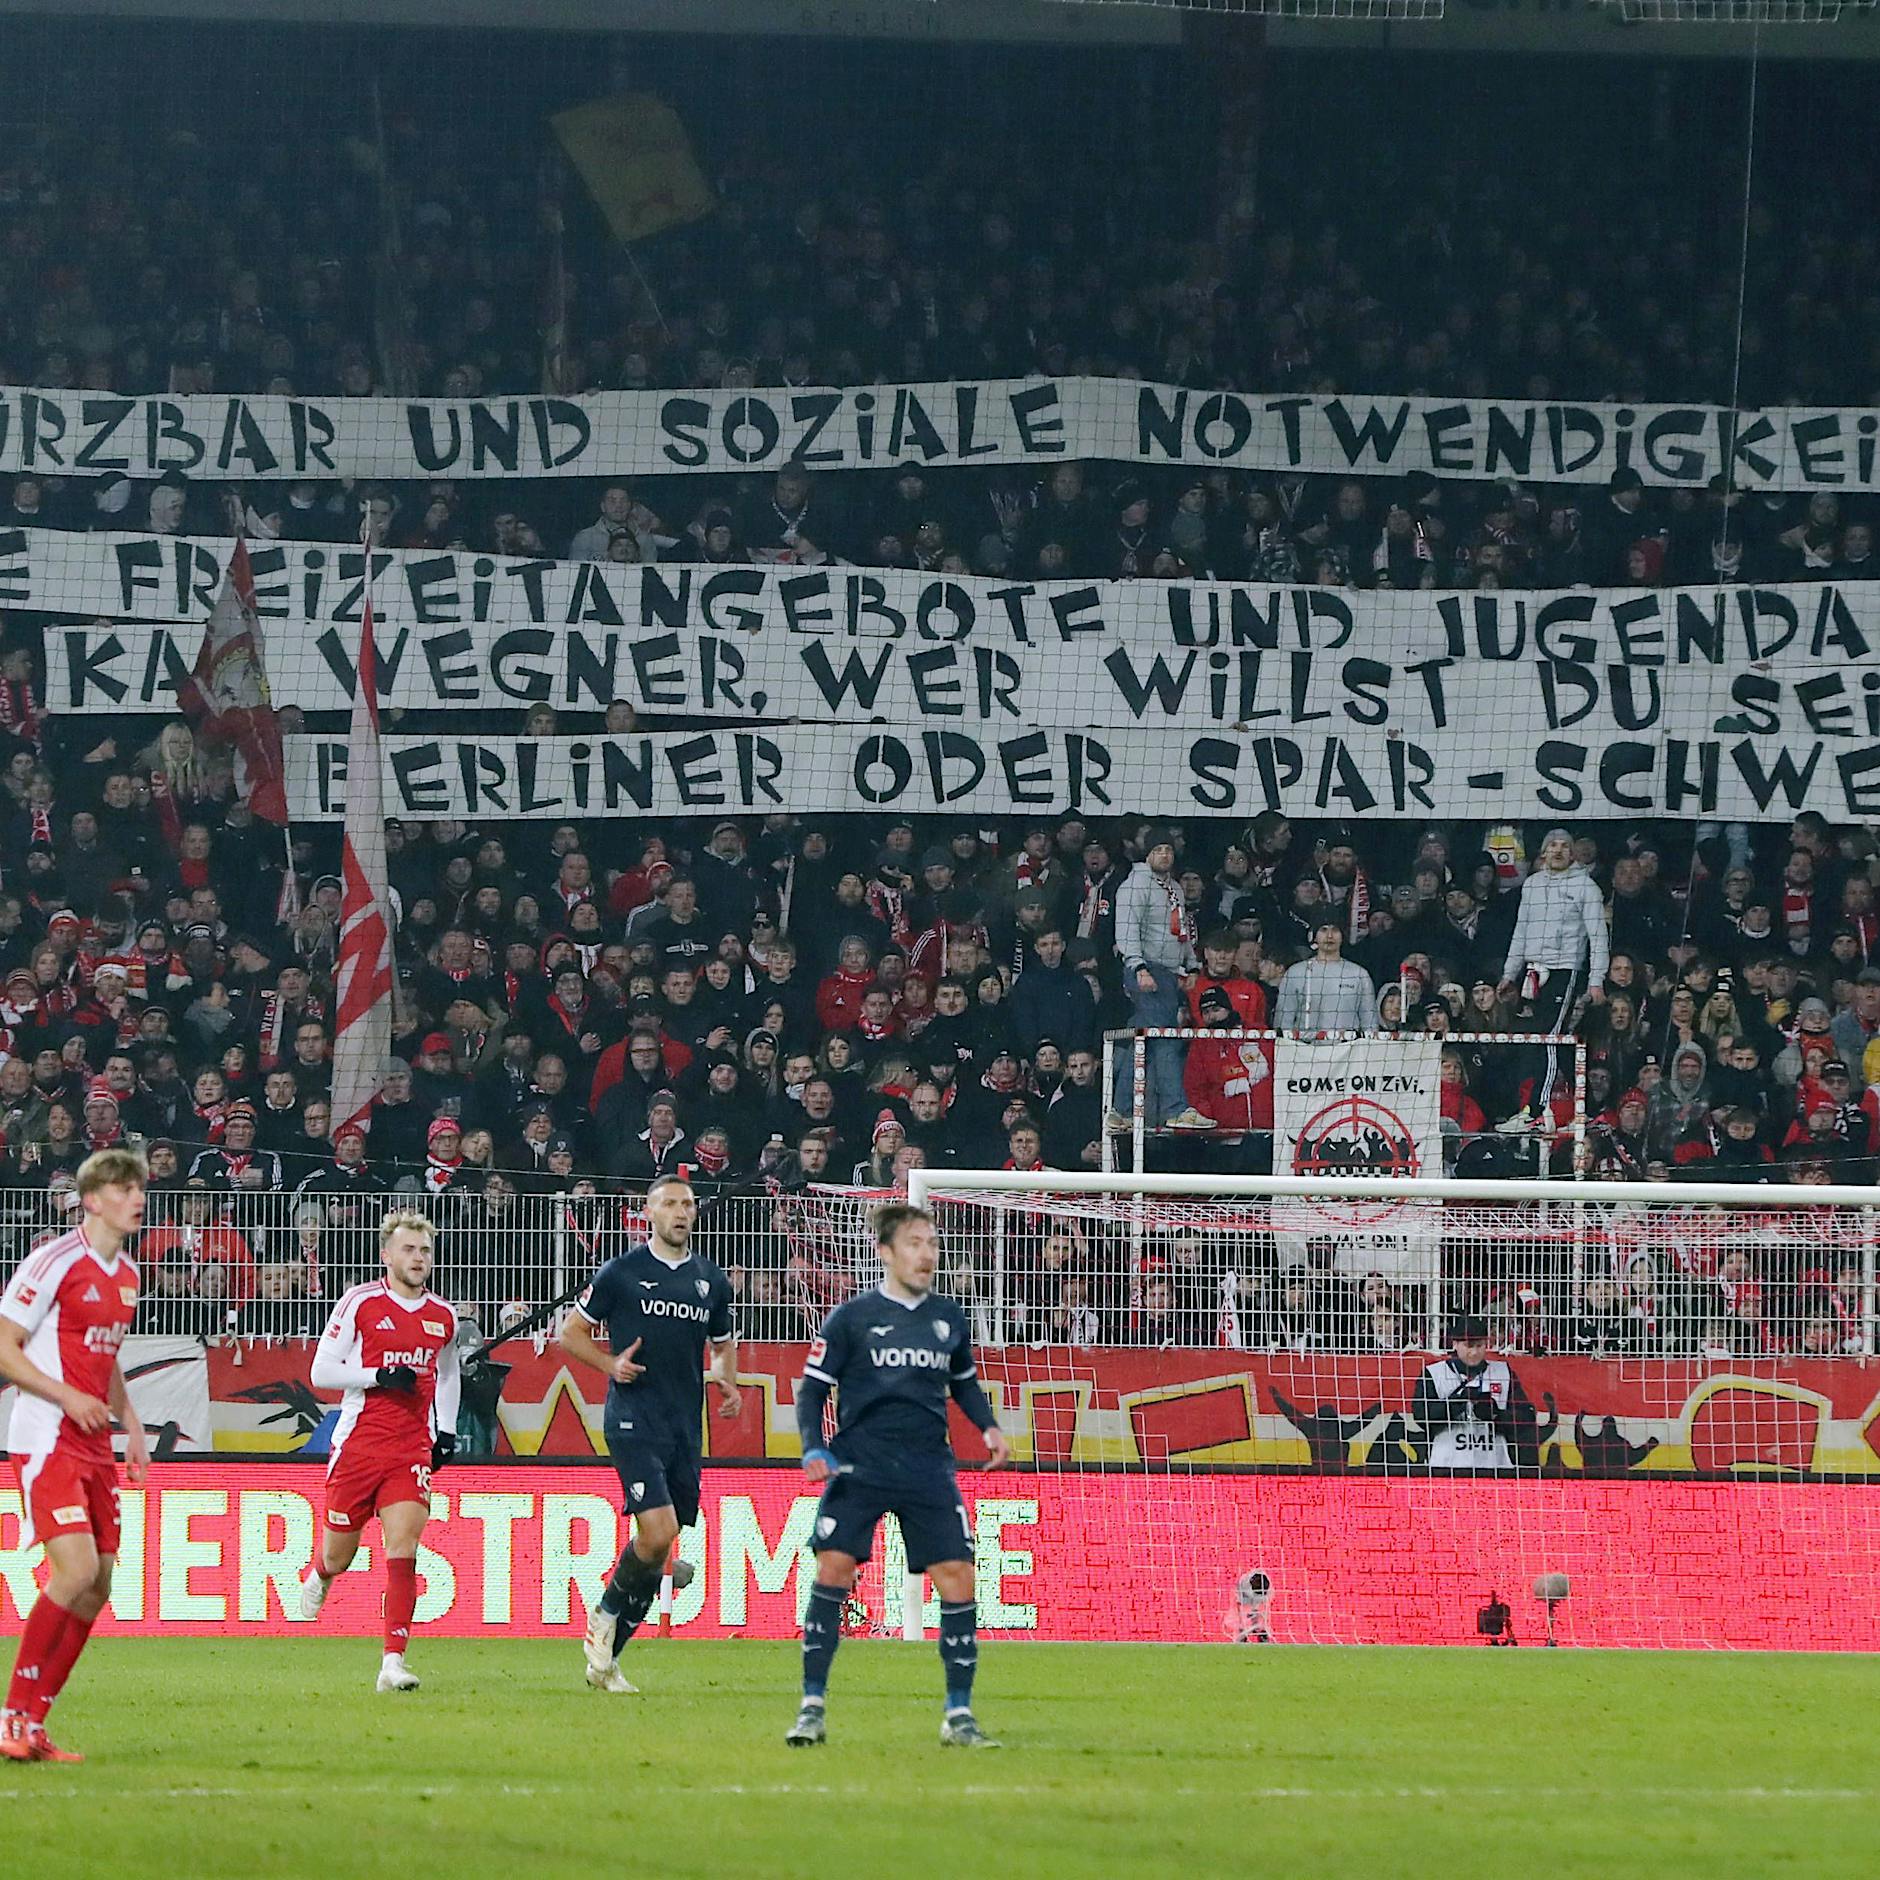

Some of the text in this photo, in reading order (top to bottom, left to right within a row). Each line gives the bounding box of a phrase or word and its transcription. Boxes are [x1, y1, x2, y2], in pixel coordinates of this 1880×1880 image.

[0, 391, 335, 473] RZBAR
[407, 397, 591, 472] UND
[1169, 587, 1353, 650] UND
[65, 629, 192, 707] KA
[316, 627, 768, 717] WEGNER,
[801, 638, 1022, 719] WER
[1537, 660, 1661, 732] DU
[854, 731, 1112, 808] ODER
[1287, 1077, 1345, 1093] COME
[1351, 1075, 1376, 1091] ON
[640, 1299, 711, 1323] VONOVIA
